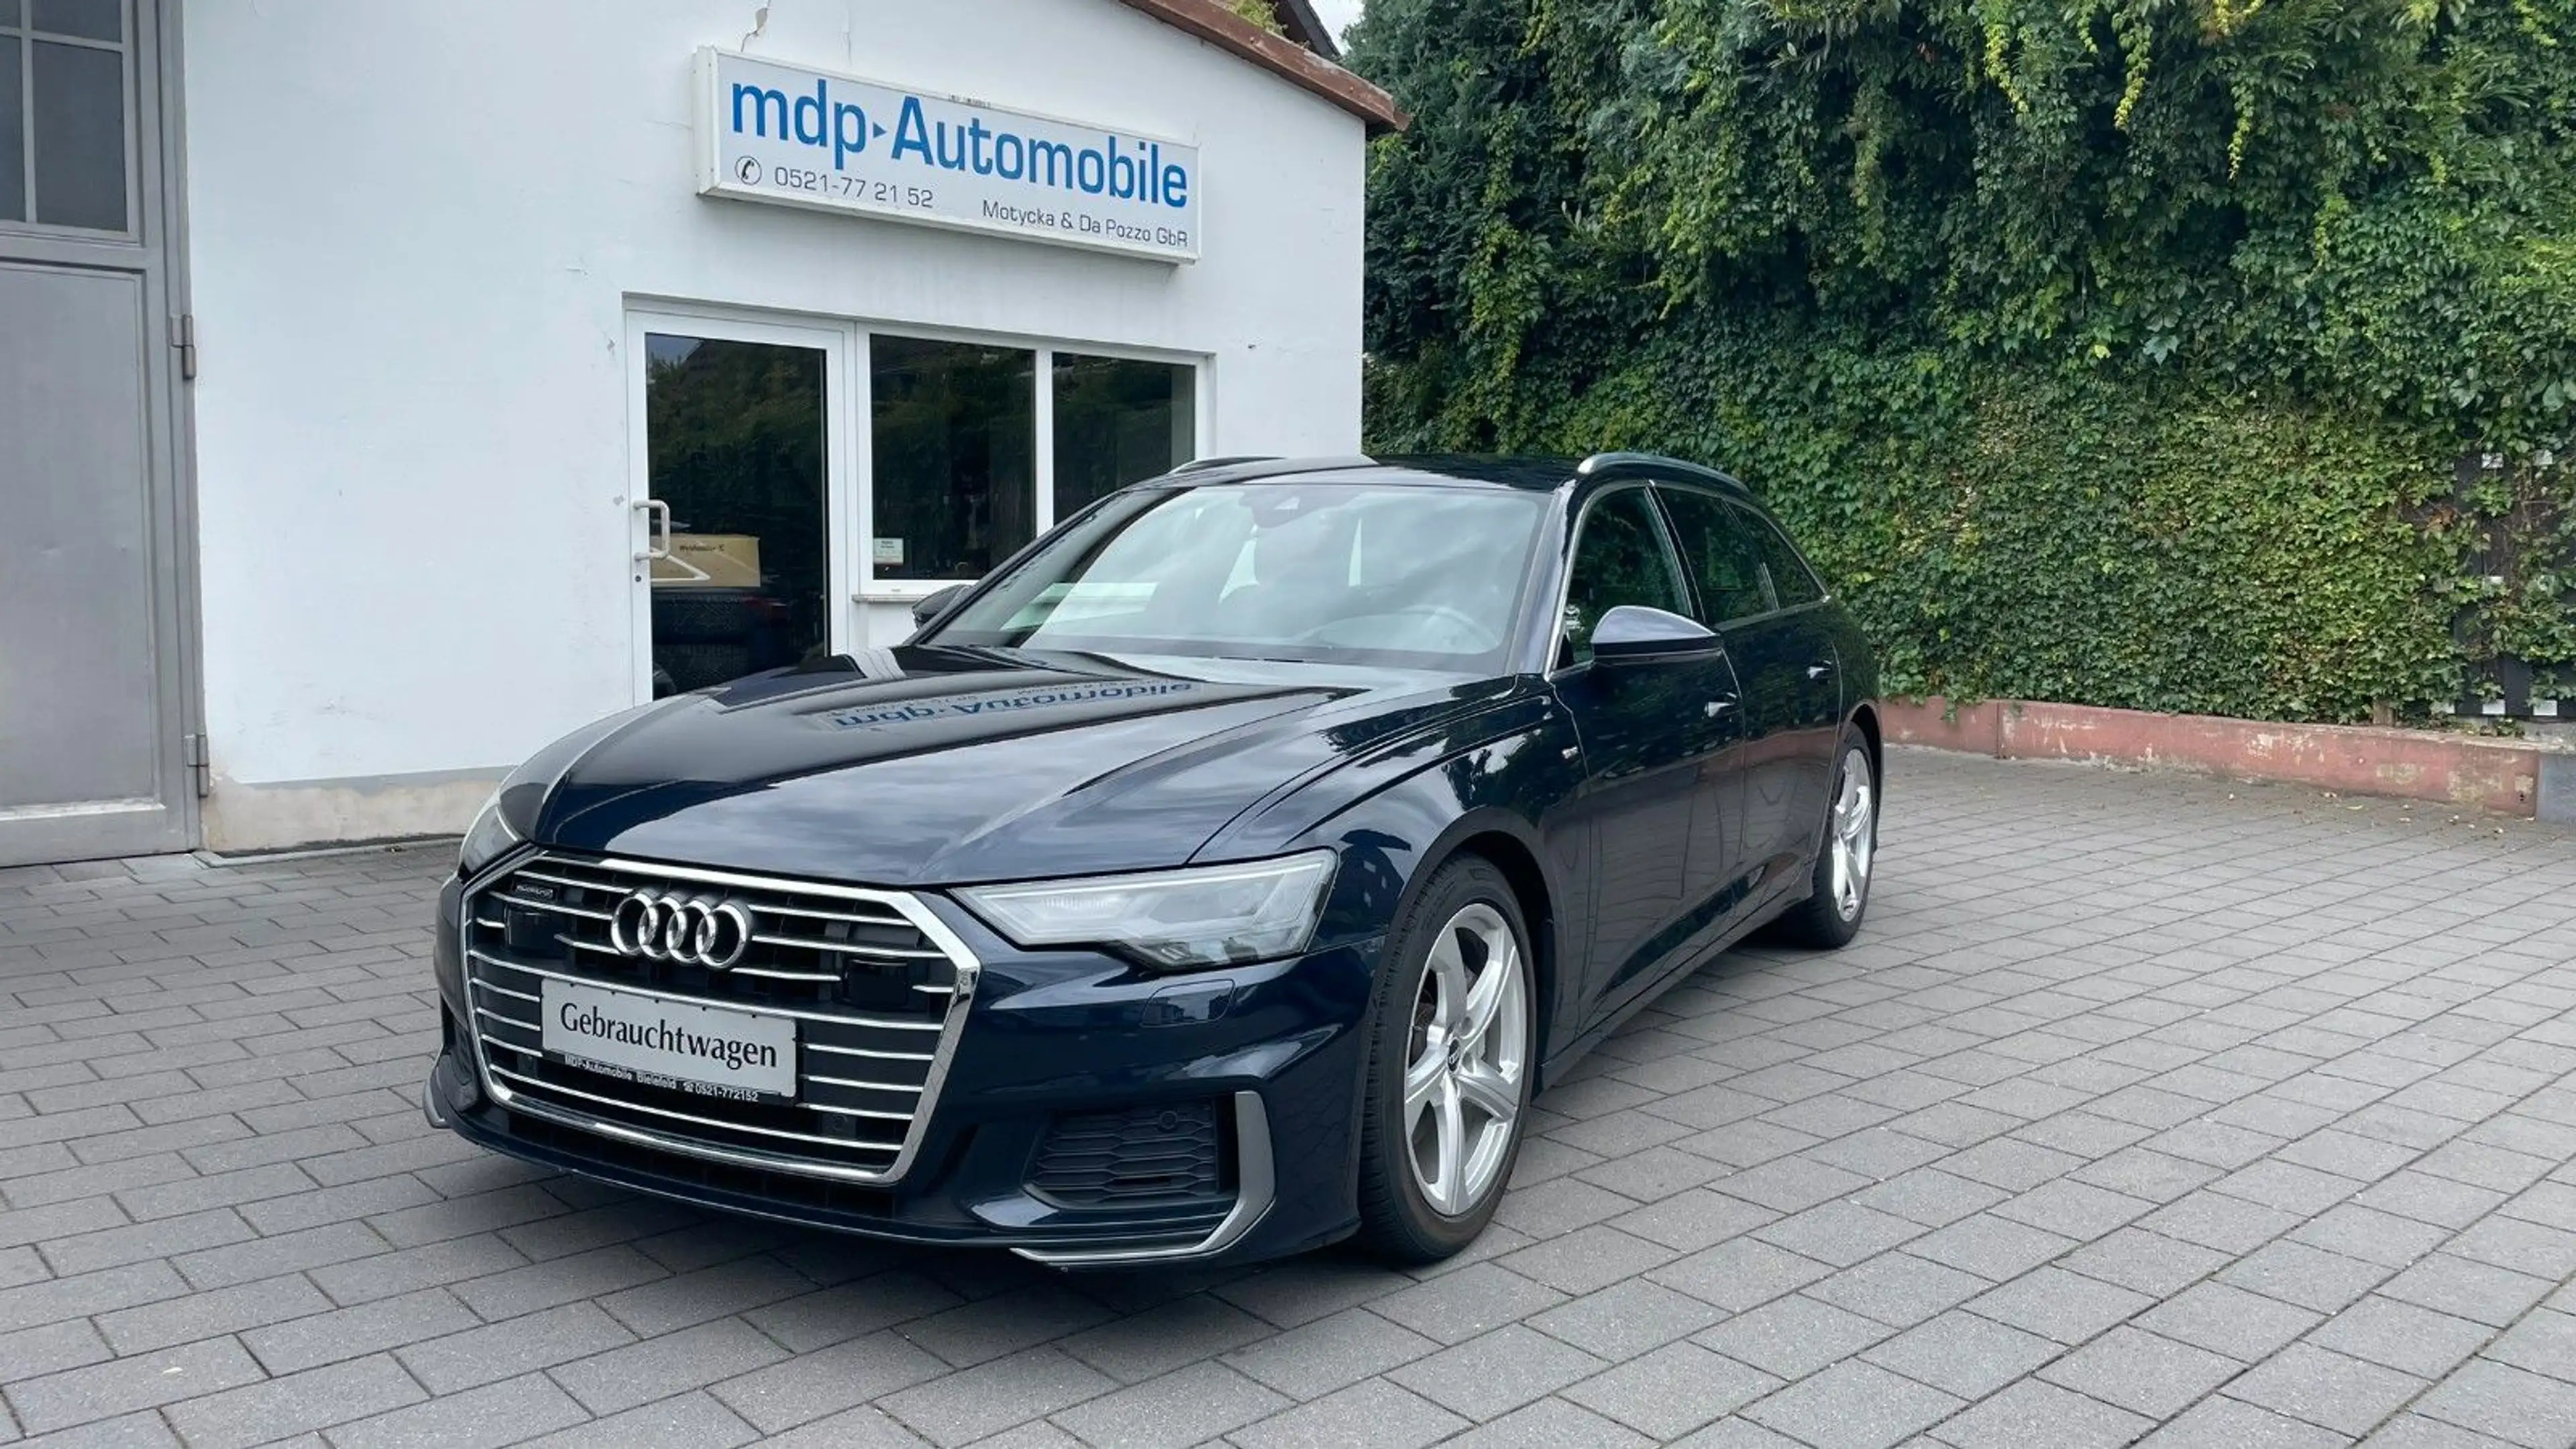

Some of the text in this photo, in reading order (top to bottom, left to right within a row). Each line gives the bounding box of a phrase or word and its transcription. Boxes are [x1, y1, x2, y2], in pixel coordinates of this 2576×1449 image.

[774, 166, 934, 209] 0521-77 21 52
[982, 199, 1187, 247] Motycka & Da Pozzo GbR
[559, 1002, 777, 1070] Gebrauchtwagen
